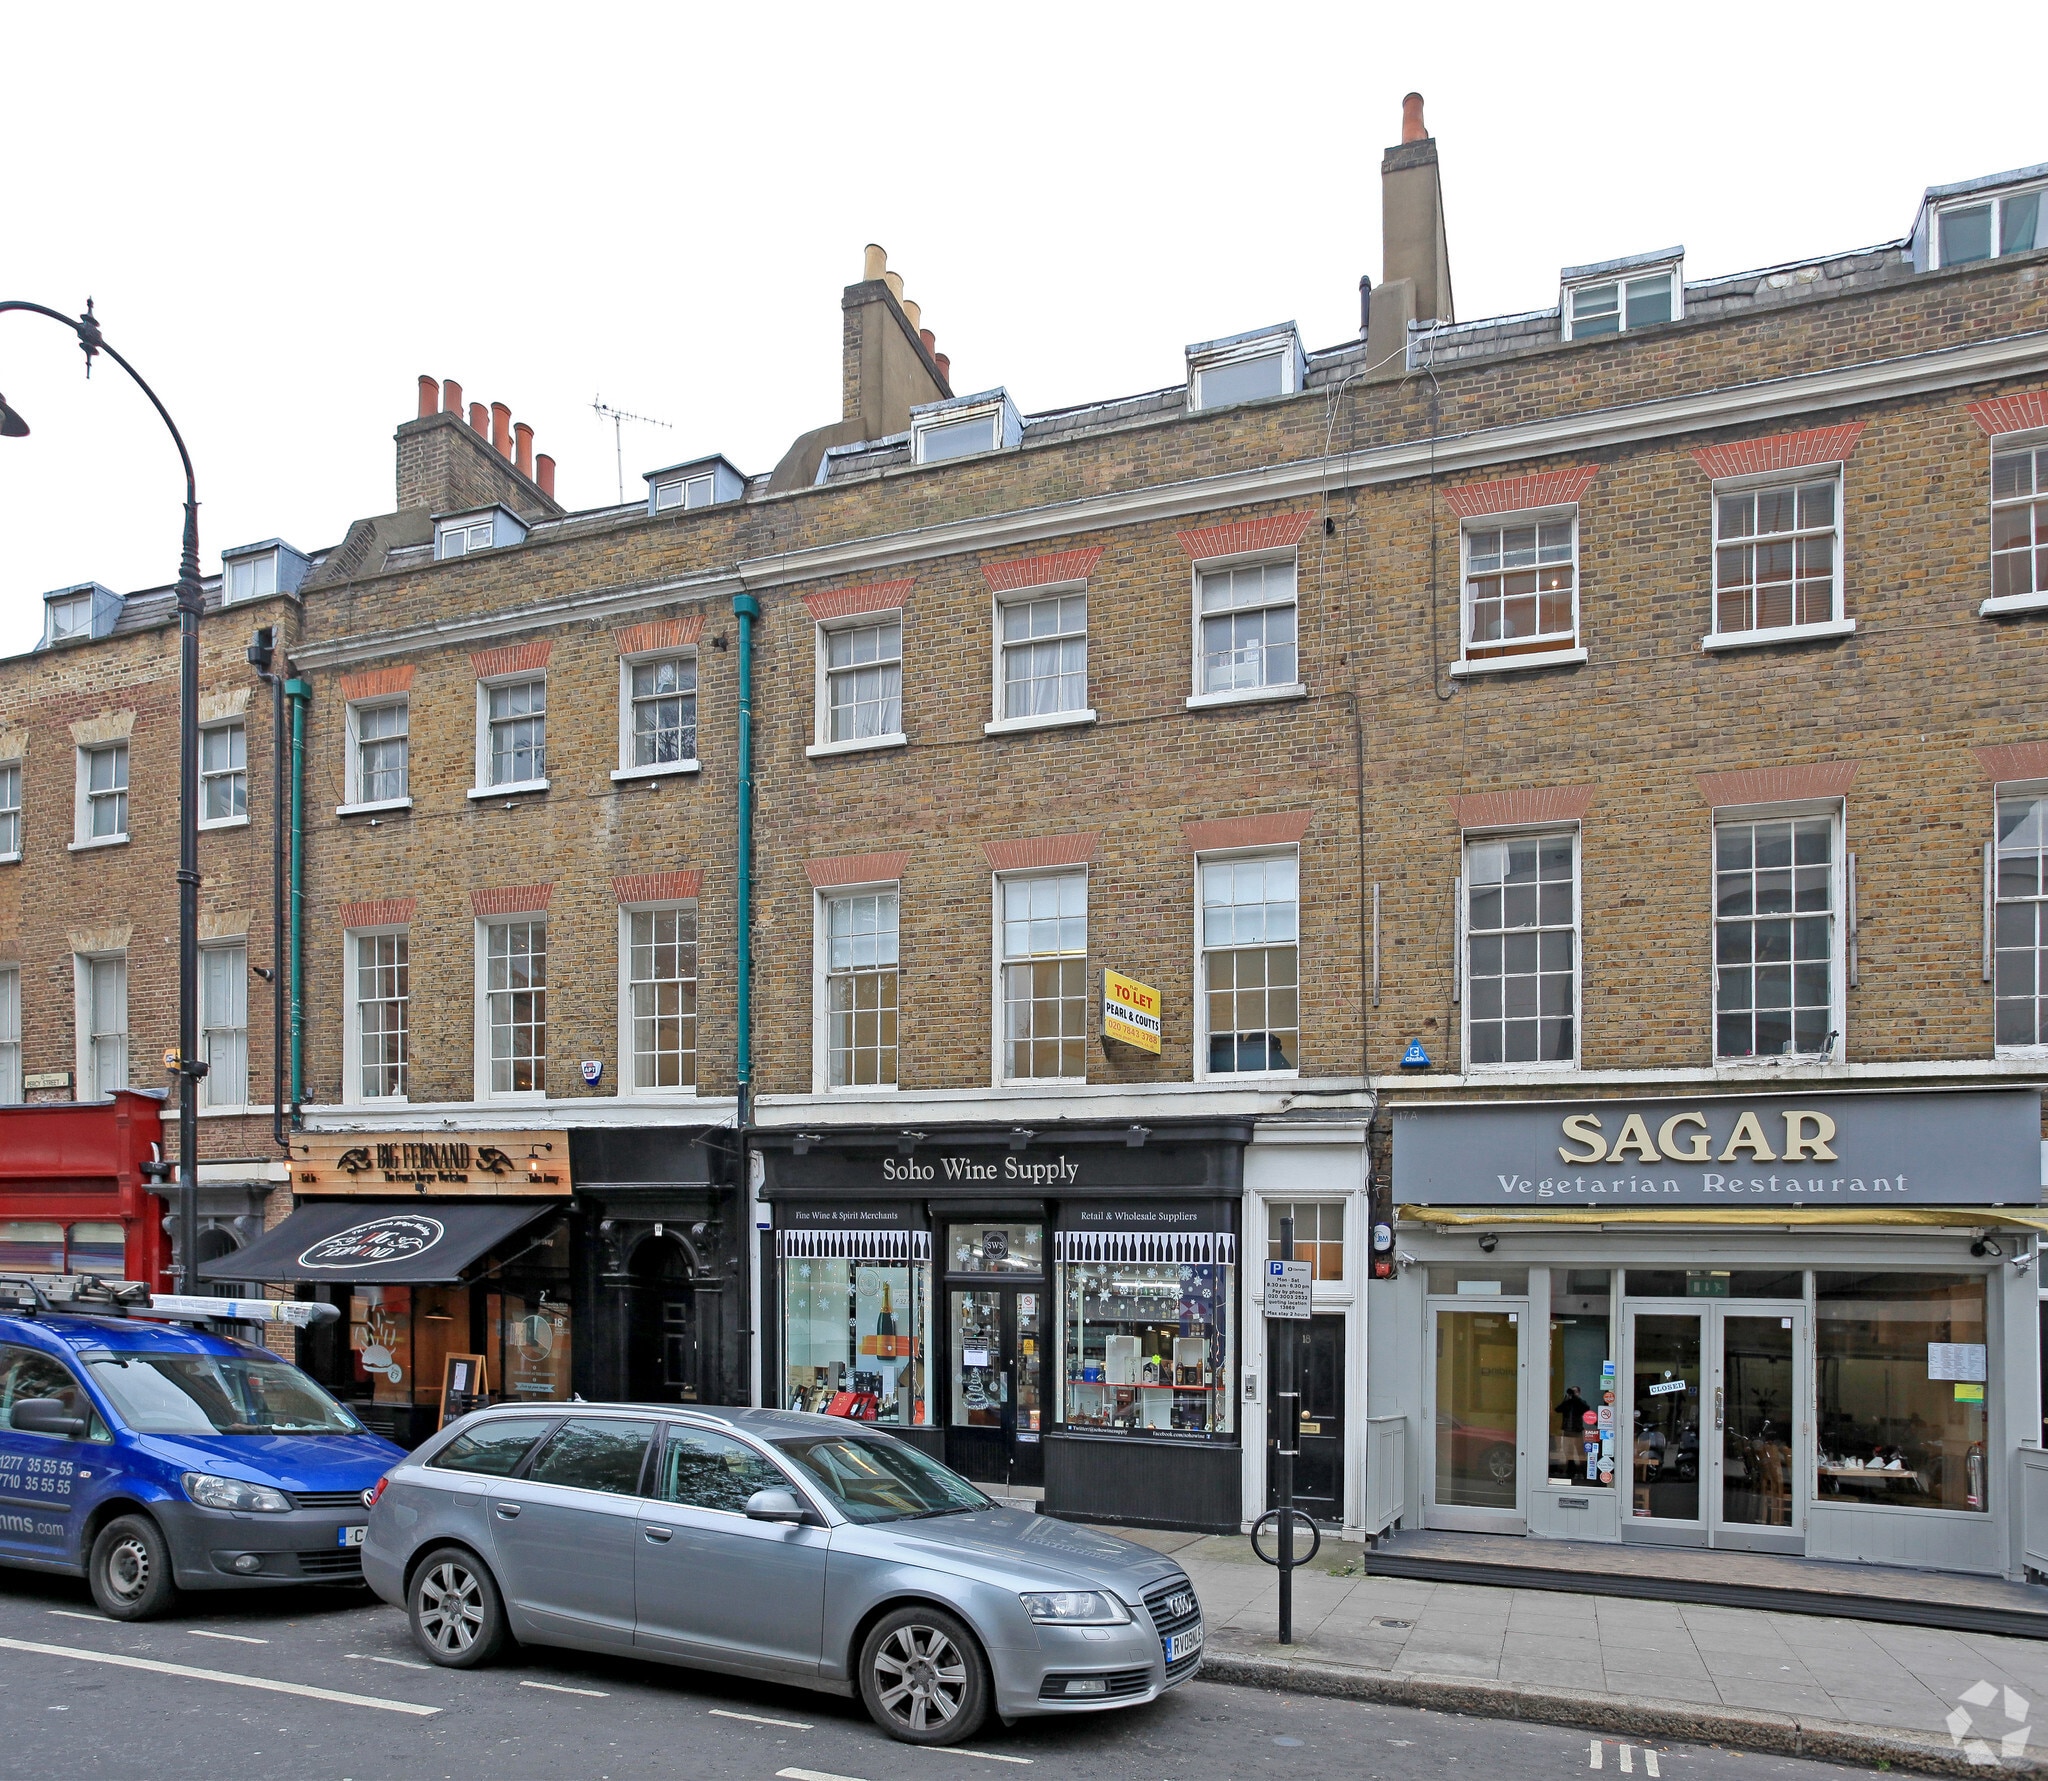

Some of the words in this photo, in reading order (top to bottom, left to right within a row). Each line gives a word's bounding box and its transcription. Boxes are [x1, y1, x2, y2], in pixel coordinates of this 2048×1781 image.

[1115, 984, 1130, 1000] TO
[1133, 992, 1152, 1009] LET
[1107, 1002, 1127, 1019] PEARL
[1128, 1010, 1134, 1022] &
[1136, 1014, 1158, 1031] COUTTS
[1109, 1020, 1121, 1031] 020
[27, 1080, 42, 1088] PERCY
[1558, 1110, 1838, 1163] SAGAR
[377, 1142, 399, 1169] BIG
[402, 1142, 471, 1169] FERNAND
[384, 1171, 395, 1182] The
[396, 1171, 415, 1182] French
[883, 1157, 935, 1181] Soho
[941, 1157, 998, 1180] Wine
[1004, 1155, 1079, 1185] Supply
[1497, 1174, 1681, 1197] Vegetarian
[1702, 1173, 1909, 1193] Restaurant
[795, 1211, 810, 1220] Fine
[811, 1211, 830, 1220] Wine
[839, 1211, 858, 1221] Spirit
[860, 1211, 898, 1220] Merchants
[1081, 1211, 1104, 1220] Retail
[1105, 1212, 1112, 1220] &
[1114, 1211, 1157, 1220] Wholesale
[1158, 1212, 1198, 1222] Suppliers
[357, 1230, 400, 1245] BIG
[316, 1245, 395, 1258] FERNAND
[987, 1241, 1004, 1249] SWS
[1273, 1263, 1281, 1274] P
[1302, 1334, 1311, 1343] 18
[1651, 1382, 1684, 1393] CLOSED
[27, 1458, 41, 1472] 35
[43, 1460, 57, 1474] 55
[59, 1461, 73, 1476] 55
[25, 1476, 38, 1490] 35
[41, 1478, 54, 1492] 55
[57, 1480, 71, 1494] 55
